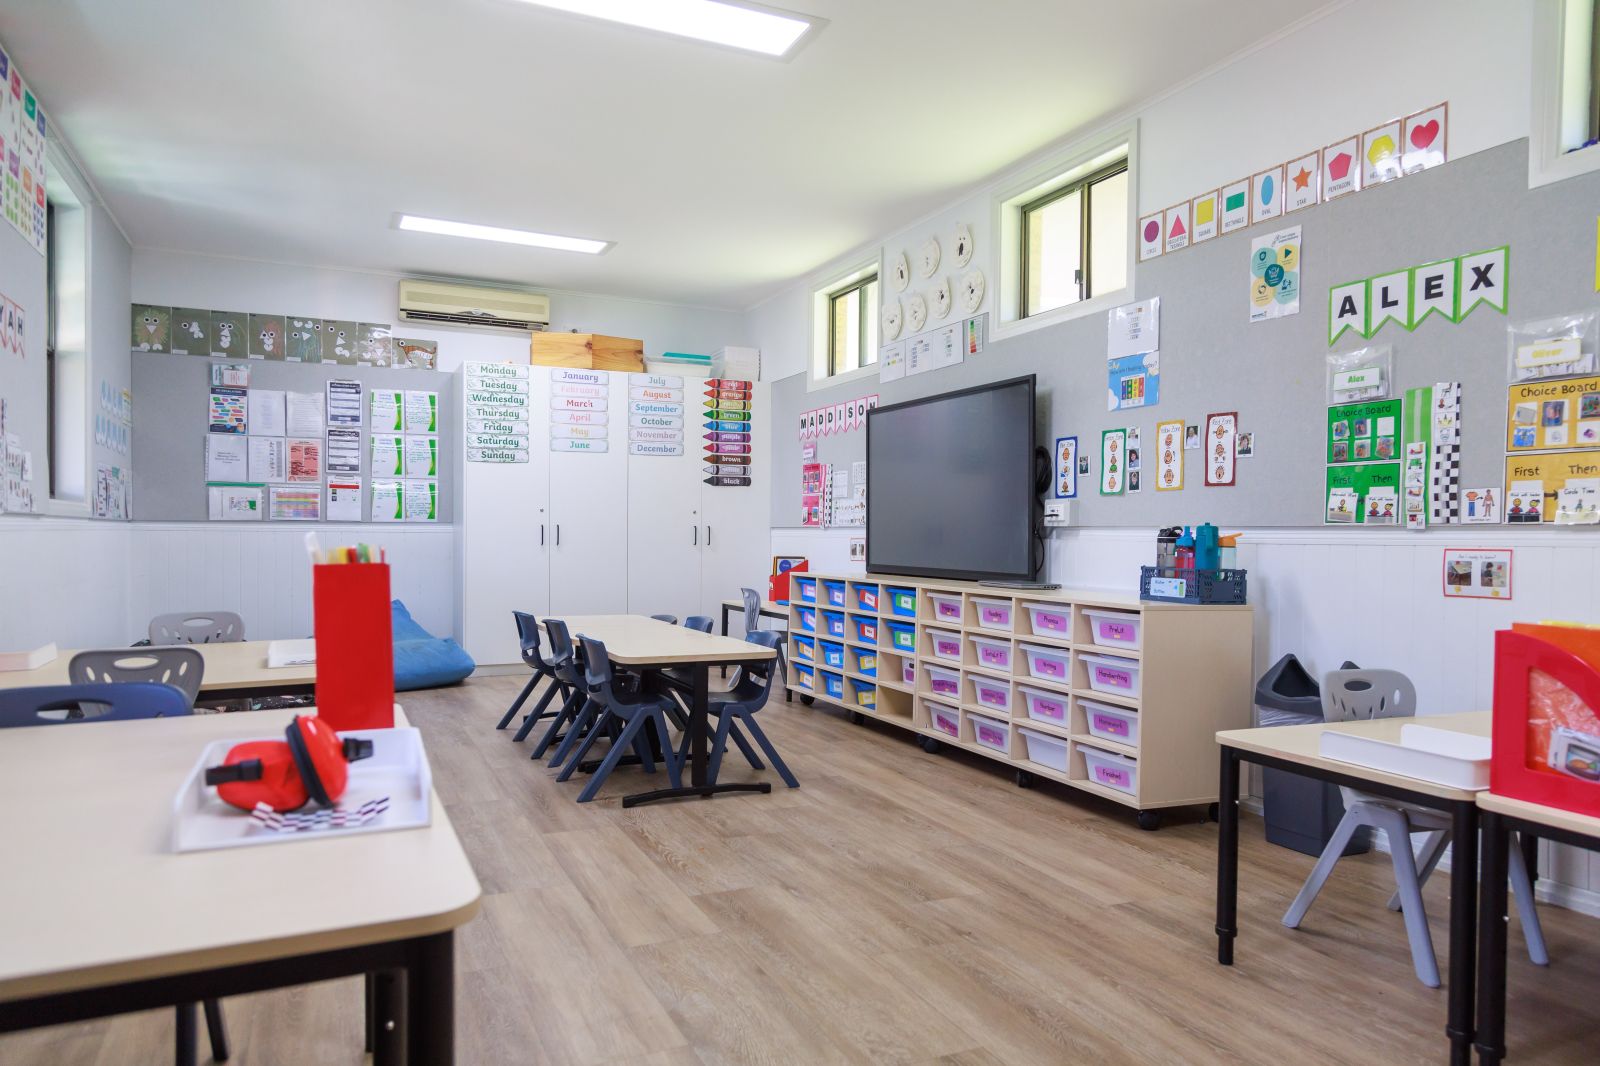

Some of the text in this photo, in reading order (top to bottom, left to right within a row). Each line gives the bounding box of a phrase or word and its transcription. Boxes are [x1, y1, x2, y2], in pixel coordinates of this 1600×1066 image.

[1328, 181, 1351, 193] PENTAGON
[1337, 262, 1495, 319] ALEX
[481, 365, 517, 377] Monday
[562, 372, 598, 383] January
[649, 377, 666, 386] July
[480, 380, 518, 391] Tuesday
[561, 385, 600, 396] February
[1521, 381, 1598, 398] Choice Board
[472, 394, 524, 405] Wednesday
[643, 390, 671, 399] August
[476, 408, 520, 419] Thursday
[635, 404, 678, 413] September
[1365, 404, 1392, 414] Board
[570, 414, 591, 422] April
[641, 418, 672, 426] October
[484, 422, 513, 433] Friday
[570, 427, 589, 437] May
[636, 431, 677, 439] November
[477, 436, 519, 447] Saturday
[570, 441, 590, 449] June
[637, 444, 676, 453] December
[481, 451, 515, 461] Sunday
[1514, 464, 1597, 476] First Then
[1372, 475, 1392, 483] Then
[1098, 670, 1127, 683] Handwriting
[1102, 768, 1121, 780] Finished
